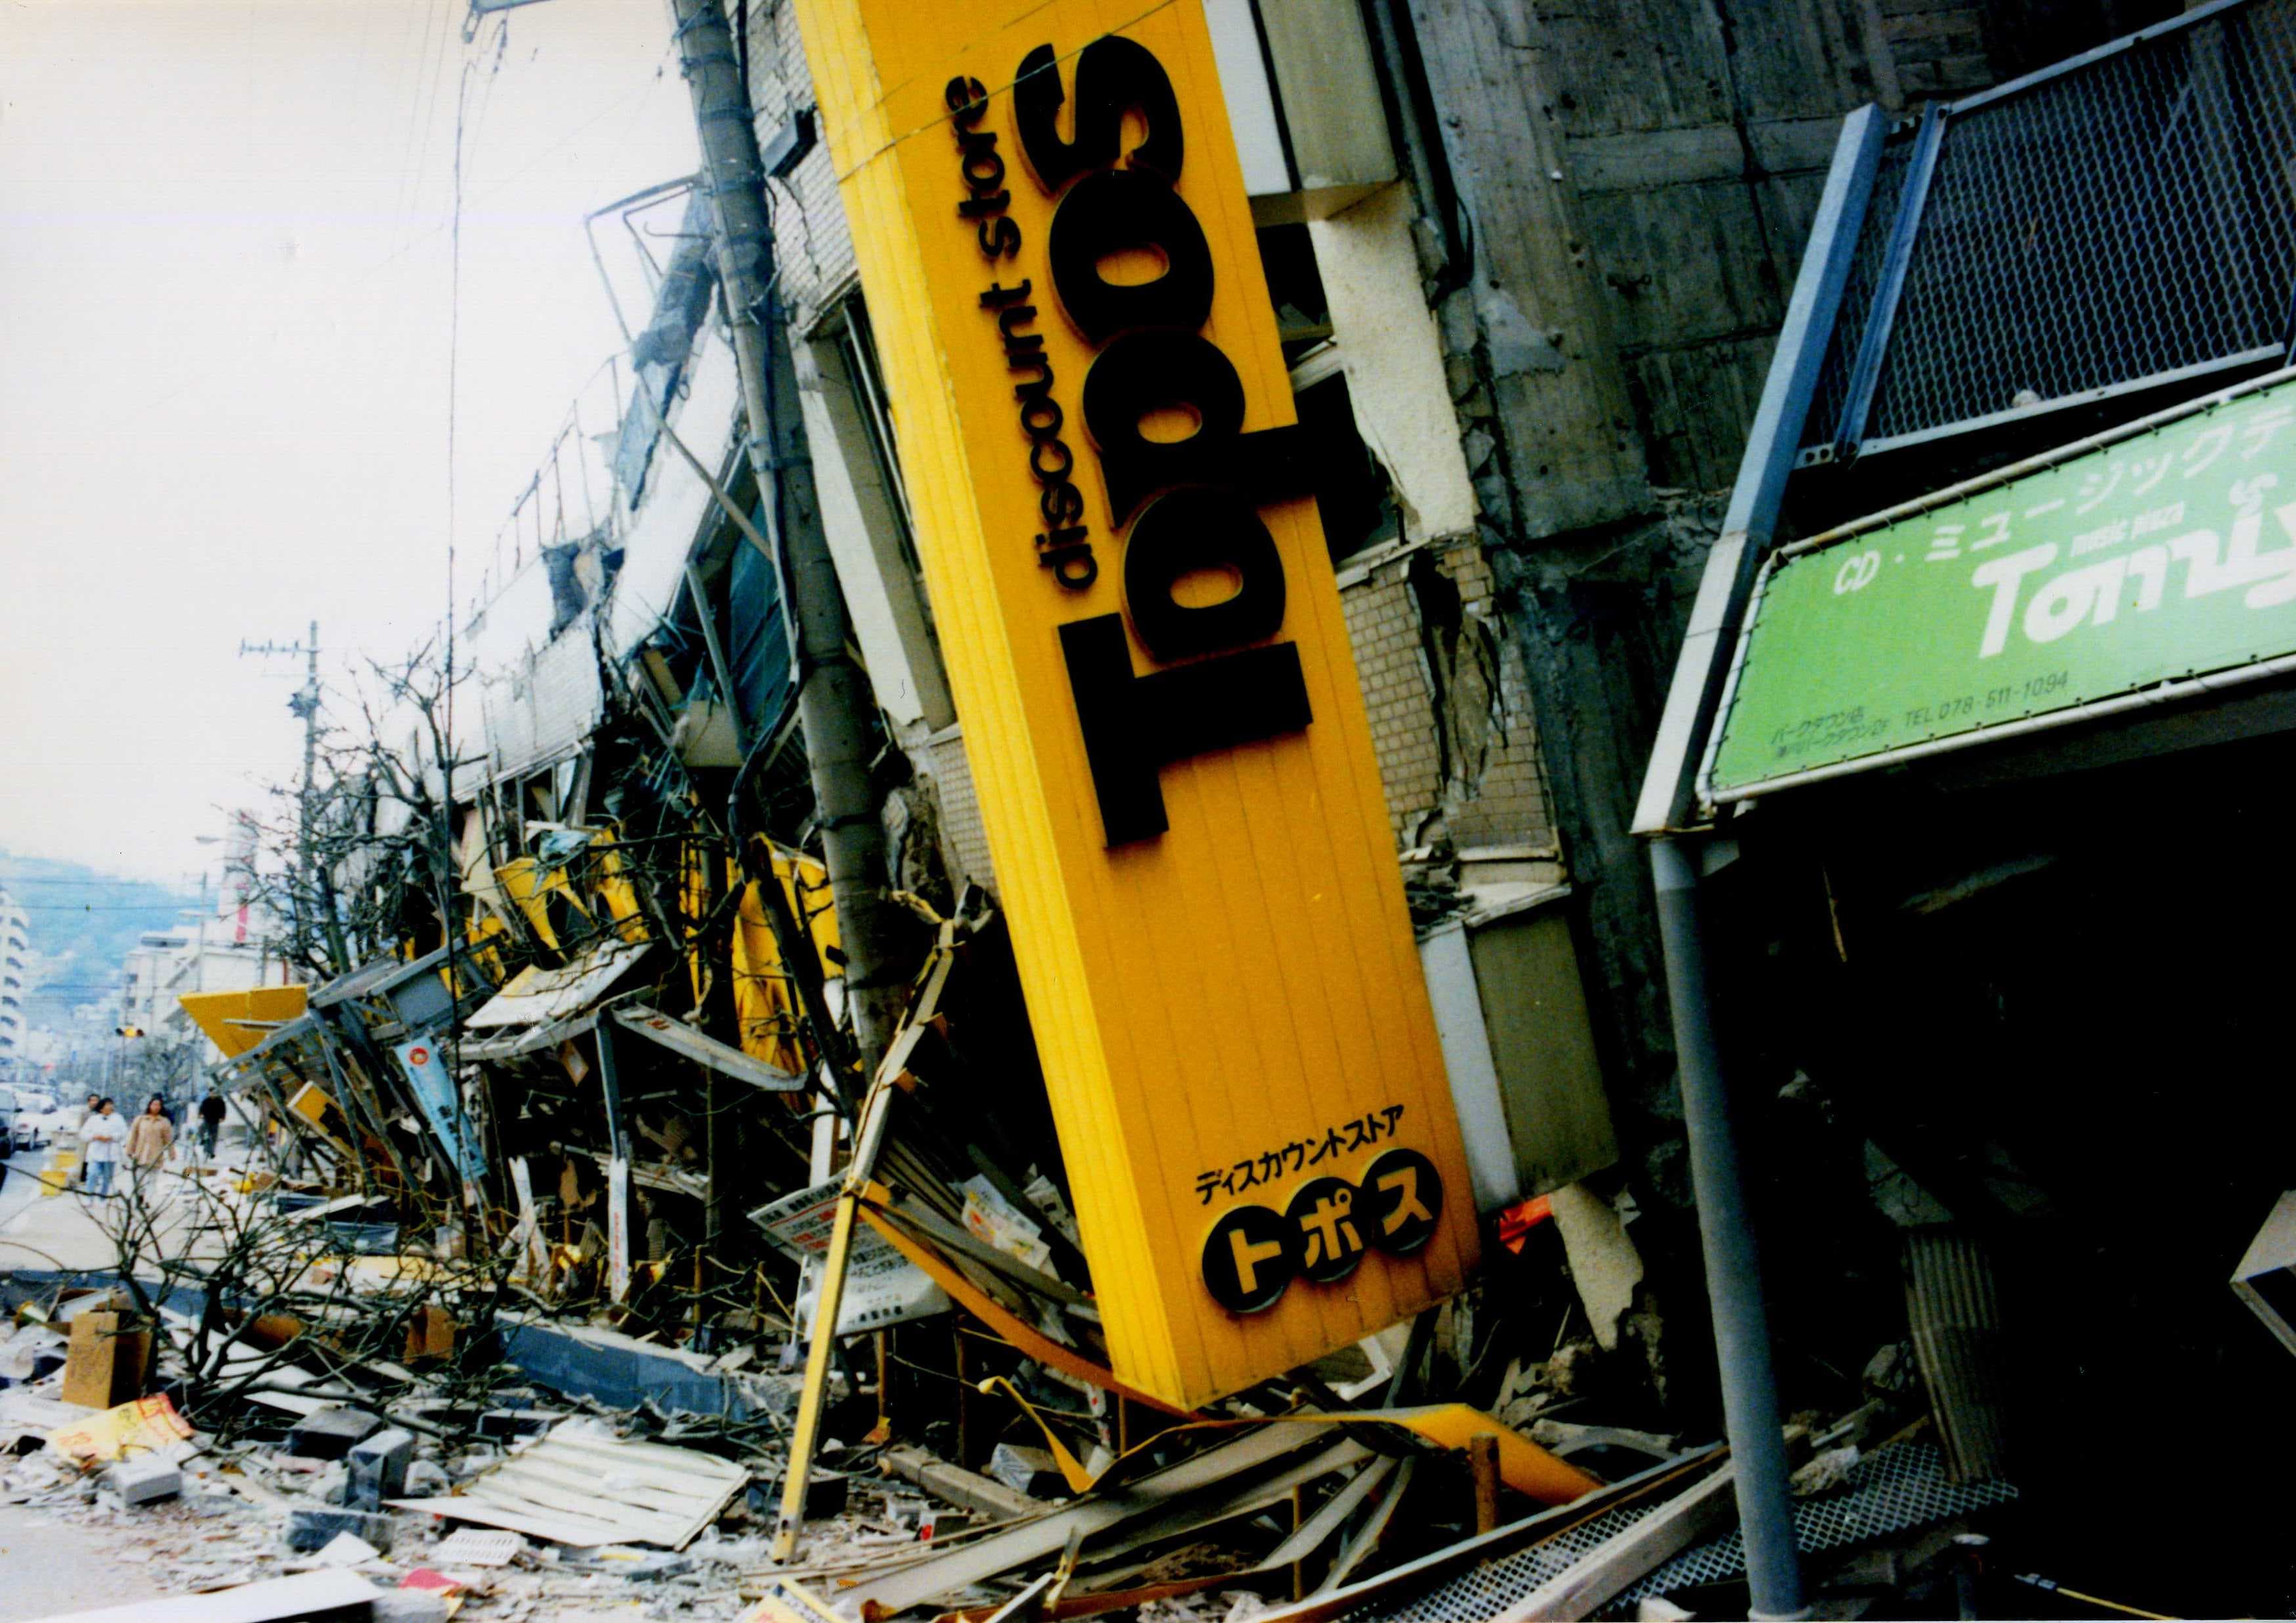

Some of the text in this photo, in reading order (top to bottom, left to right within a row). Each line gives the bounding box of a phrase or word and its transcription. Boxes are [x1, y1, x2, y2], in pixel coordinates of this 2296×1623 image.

[945, 75, 1098, 590] discount store
[1905, 706, 1933, 727] TEL
[1195, 1104, 1405, 1206] ディスカウントストア
[1227, 1165, 1434, 1296] トポス
